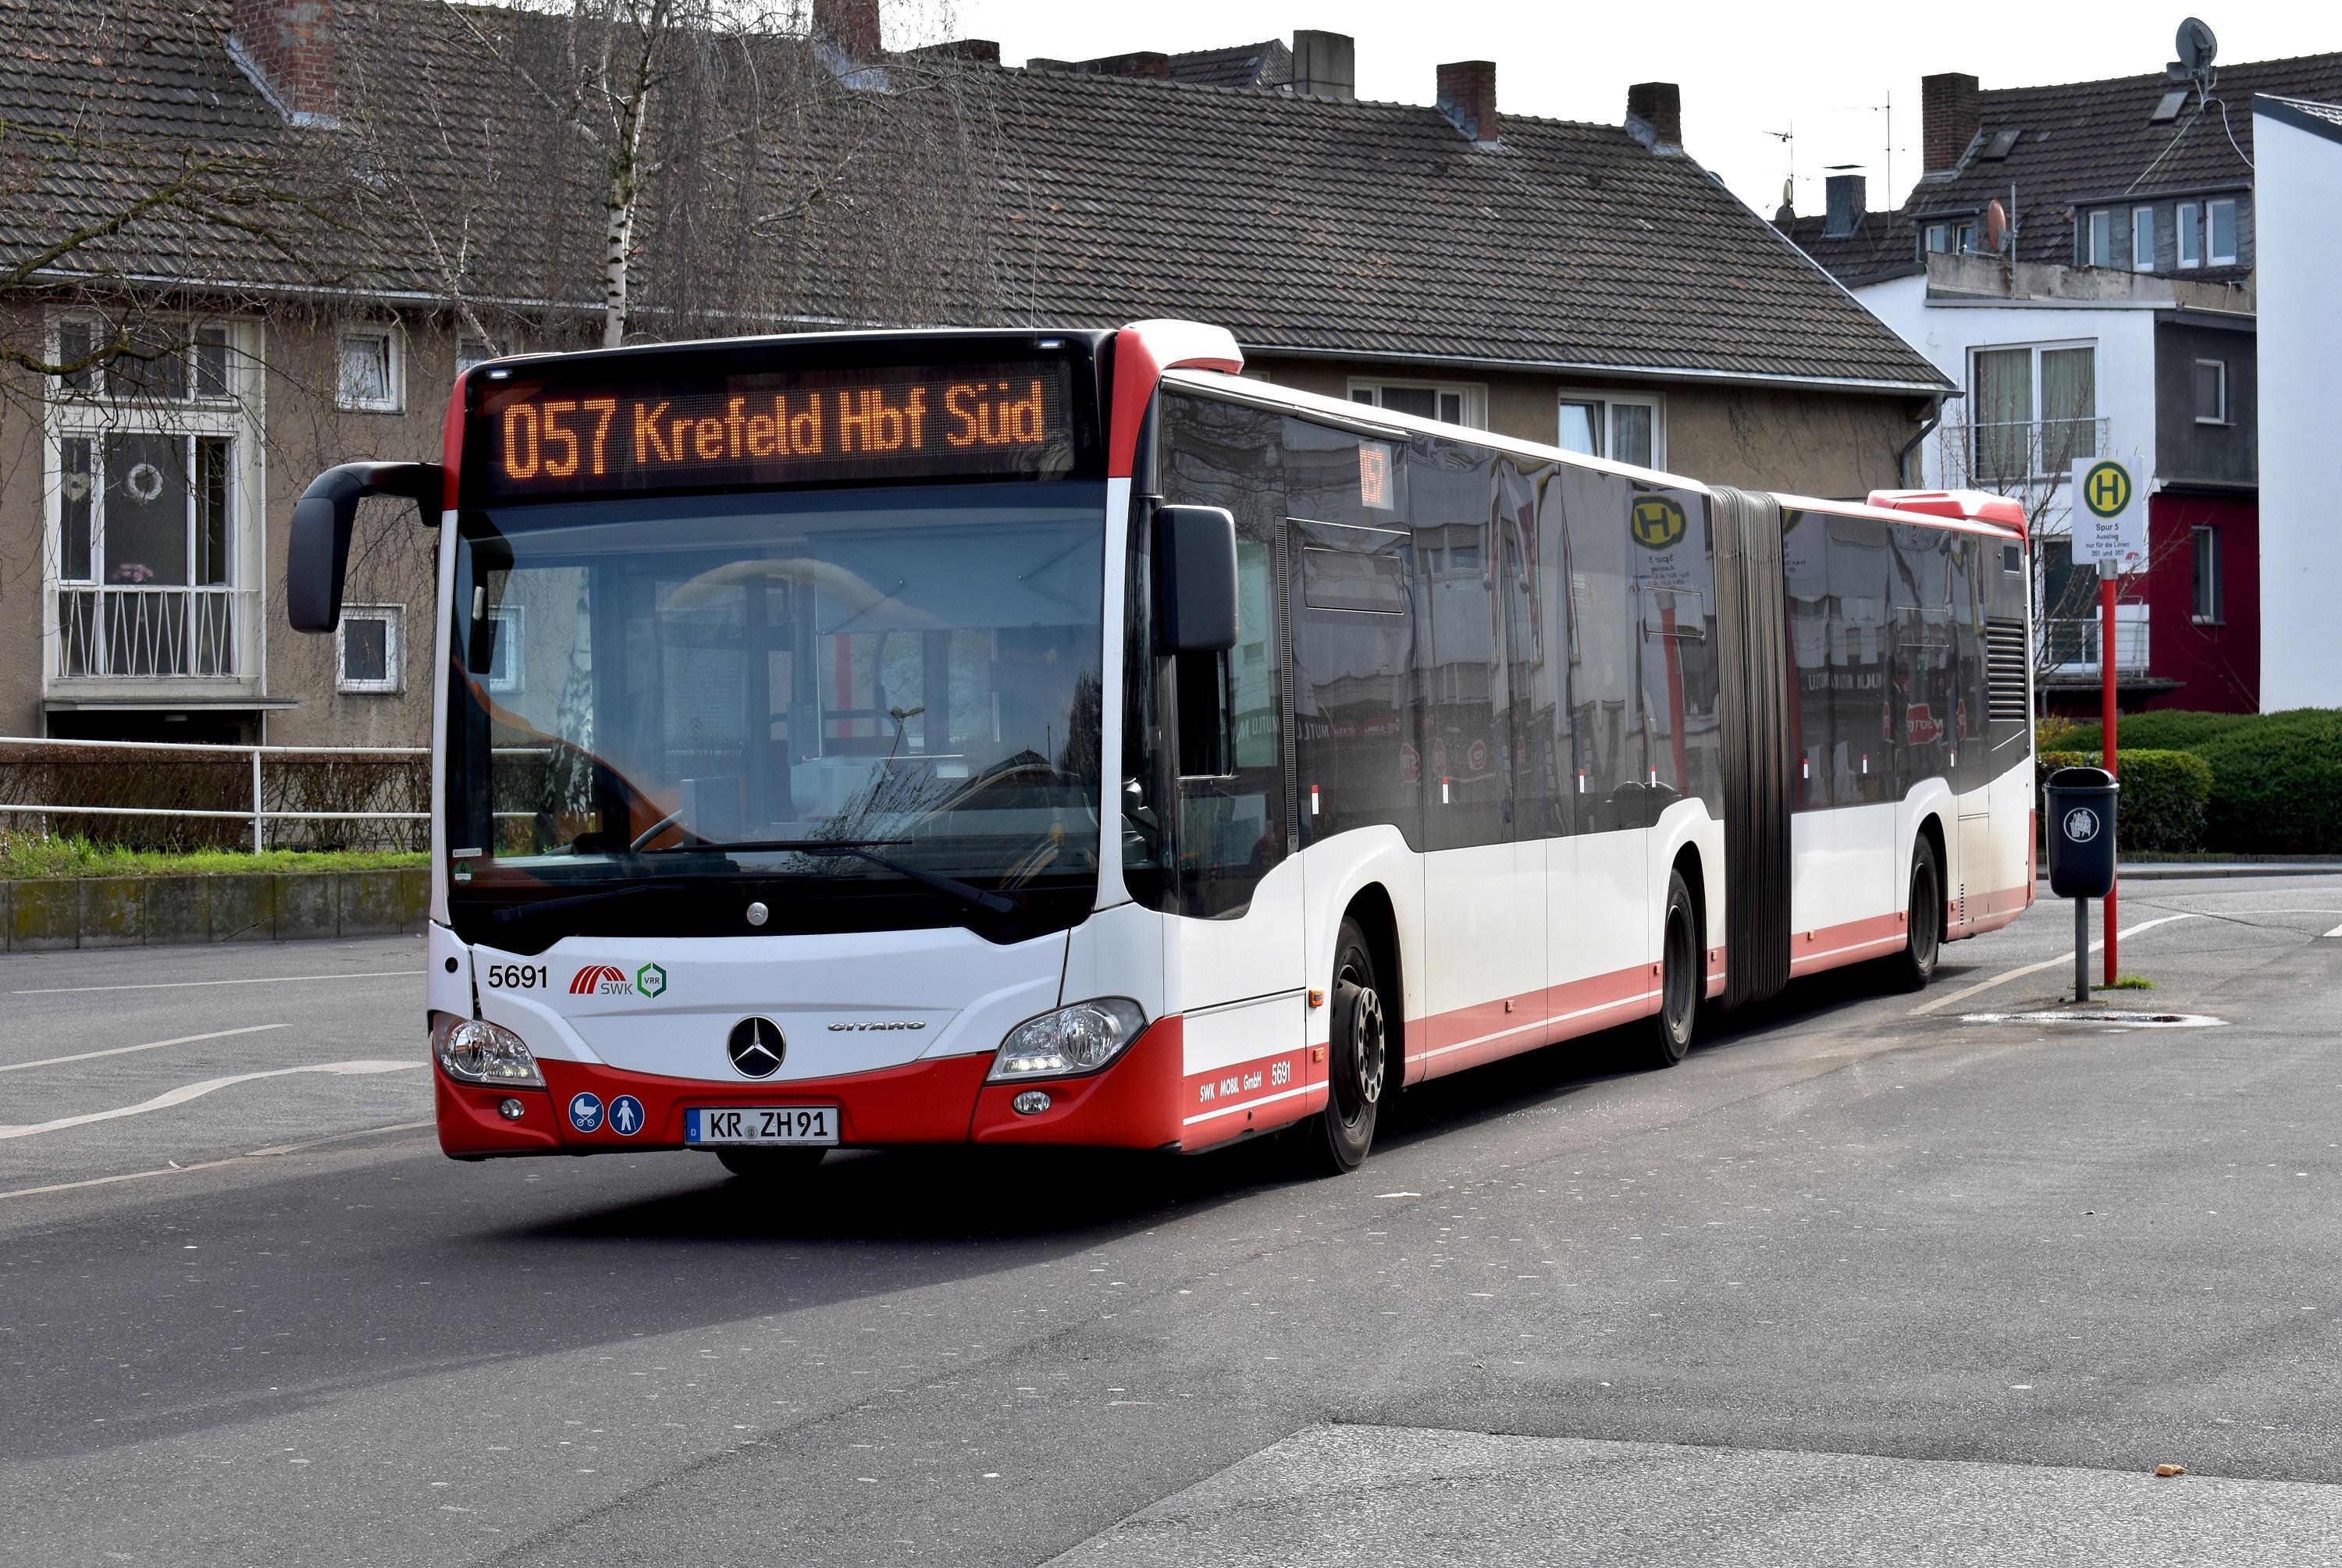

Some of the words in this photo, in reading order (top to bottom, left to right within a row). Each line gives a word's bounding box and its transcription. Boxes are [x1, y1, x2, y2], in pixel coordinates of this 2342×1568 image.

[504, 396, 618, 479] 057
[633, 391, 823, 464] Krefeld
[838, 386, 927, 453] Hbf
[944, 380, 1045, 446] Süd
[2096, 474, 2119, 506] H
[488, 965, 547, 989] 5691
[600, 983, 633, 995] SWK
[828, 1020, 926, 1031] CITARO
[1200, 1083, 1215, 1103] SWK
[1219, 1076, 1240, 1097] MOBIL
[1243, 1071, 1262, 1091] GmbH
[1271, 1060, 1291, 1086] 5691
[690, 1129, 696, 1137] D
[710, 1112, 742, 1138] KR
